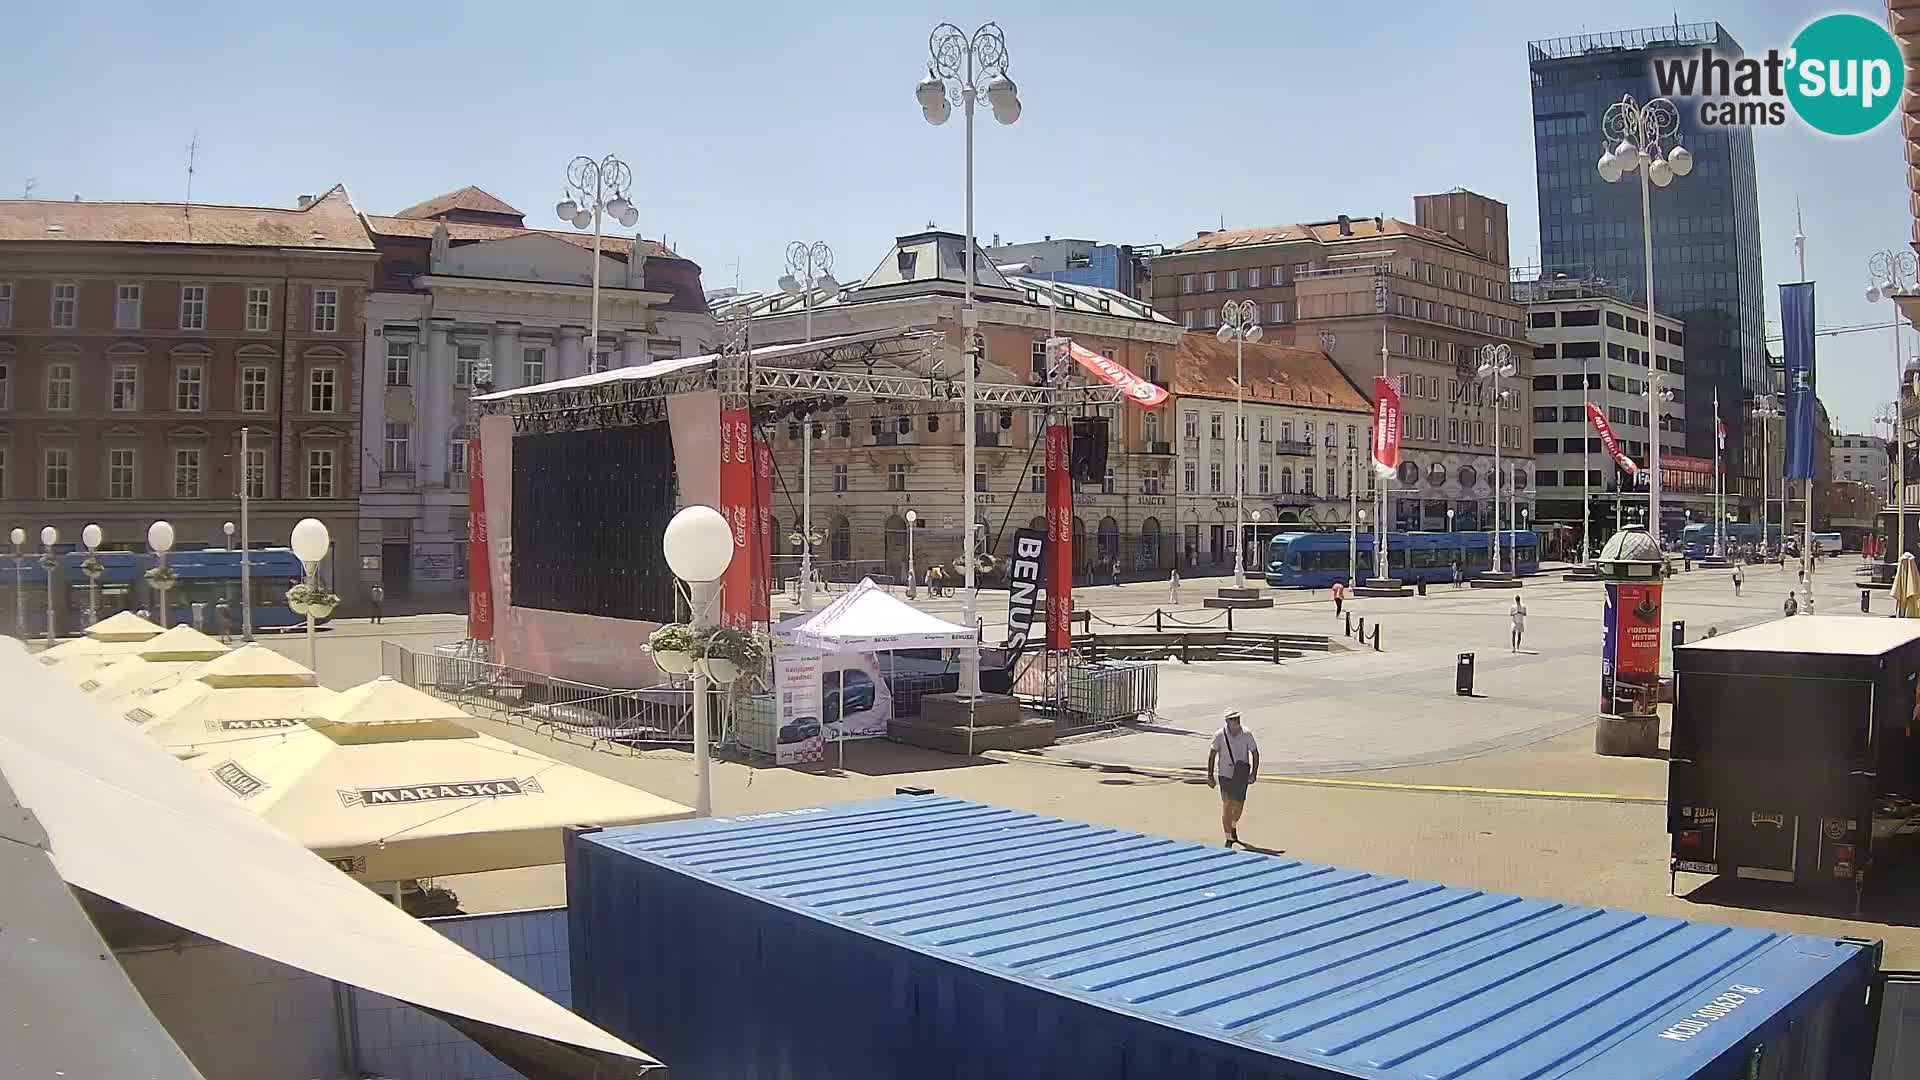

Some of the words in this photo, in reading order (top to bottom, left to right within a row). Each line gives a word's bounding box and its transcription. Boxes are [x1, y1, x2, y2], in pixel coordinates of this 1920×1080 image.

[735, 421, 748, 464] Coca-Cola
[734, 504, 746, 548] Coca-Cola
[371, 782, 515, 803] MARASKA
